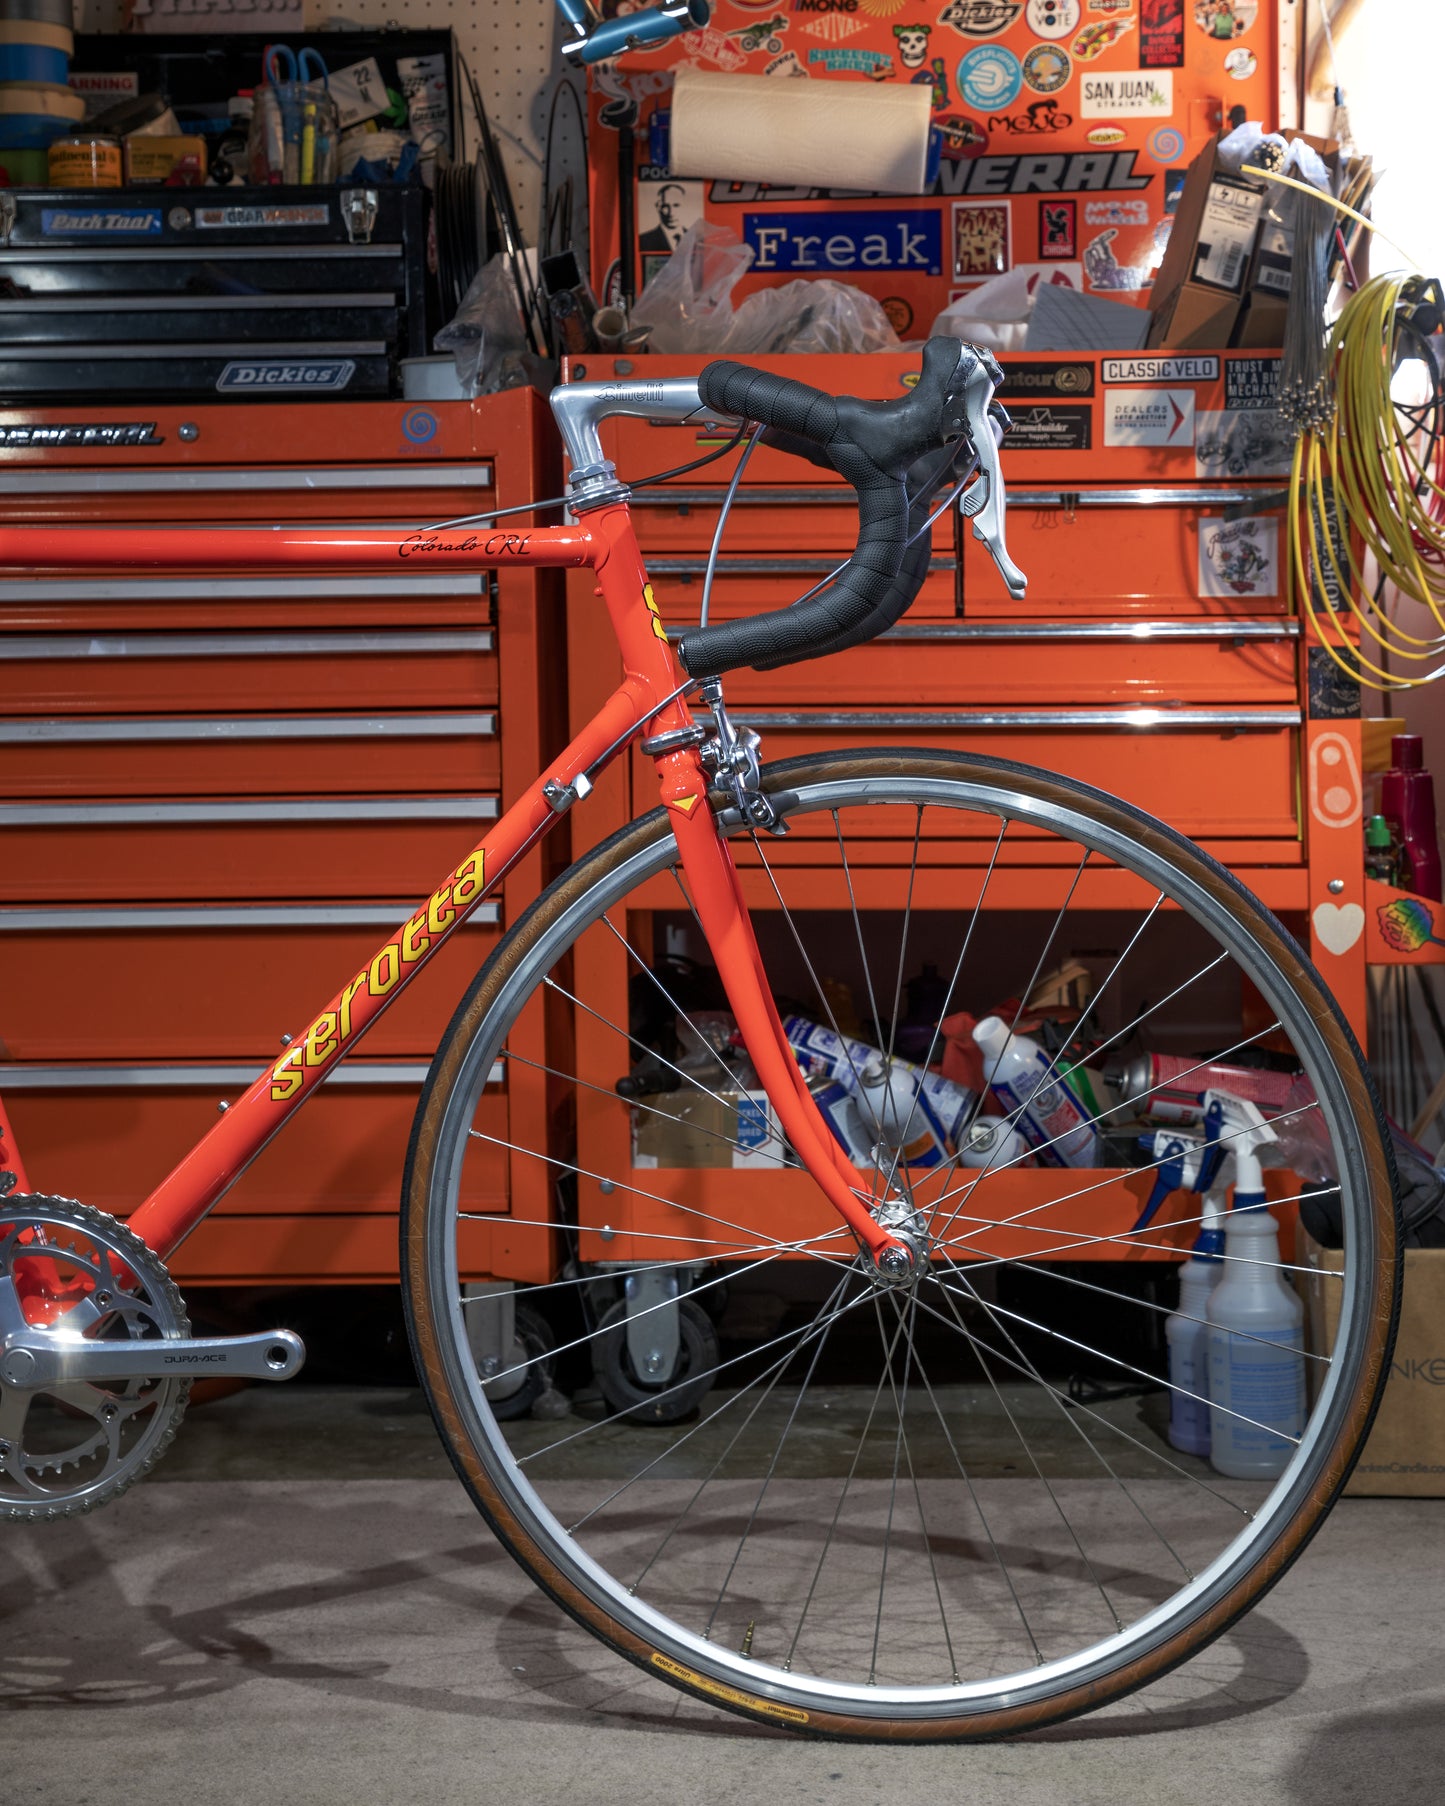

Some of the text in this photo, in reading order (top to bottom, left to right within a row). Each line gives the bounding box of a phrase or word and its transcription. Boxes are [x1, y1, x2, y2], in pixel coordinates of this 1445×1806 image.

[805, 13, 862, 42] REVIVAL
[68, 77, 133, 90] ARNING
[353, 65, 372, 85] 22
[1085, 80, 1155, 100] SAN JUAN
[755, 224, 929, 267] Freak
[1042, 246, 1073, 256] CHROME
[1108, 360, 1213, 378] CLASSIC VELO
[1227, 360, 1263, 373] TRUST
[233, 367, 334, 384] Dickies
[1250, 372, 1258, 384] A
[597, 383, 664, 402] Cinelli
[1115, 405, 1168, 414] DEALERS
[399, 534, 532, 557] Colorado CRL
[1322, 559, 1340, 612] SHOP
[271, 848, 486, 1101] serotta
[164, 1354, 227, 1364] DURA-ACE
[655, 1656, 673, 1669] 2000
[674, 1666, 692, 1679] Ultra
